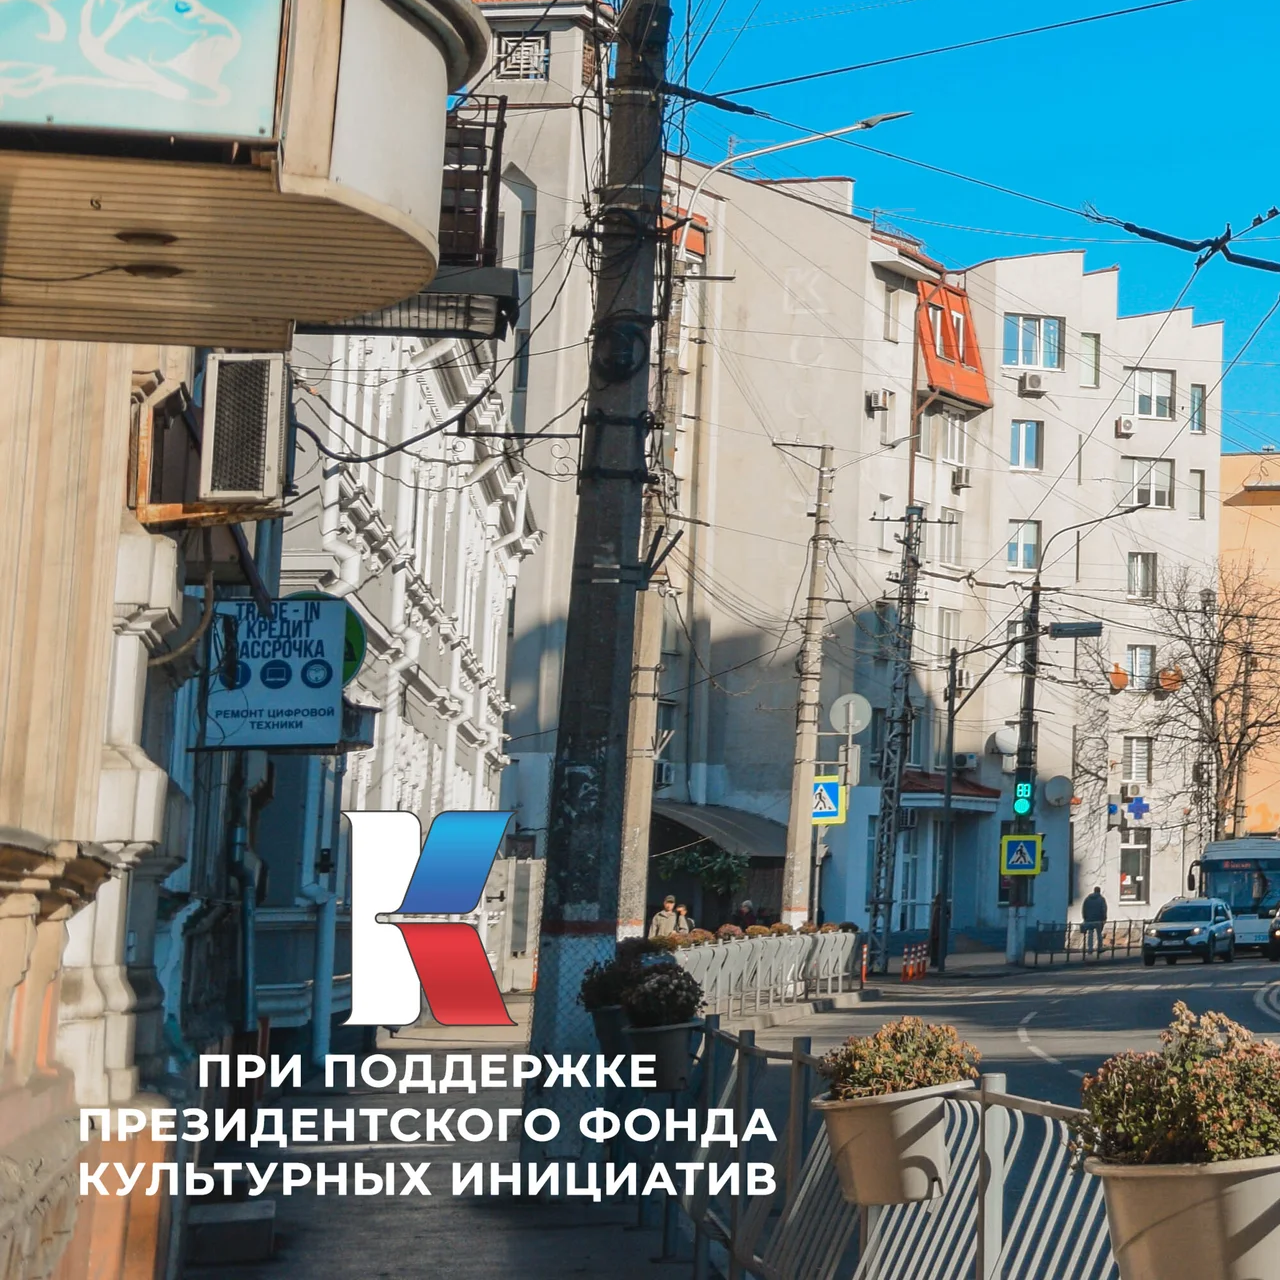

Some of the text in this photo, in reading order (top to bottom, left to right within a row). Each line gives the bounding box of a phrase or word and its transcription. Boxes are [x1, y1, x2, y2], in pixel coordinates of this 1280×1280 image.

[304, 602, 320, 619] IN
[246, 620, 313, 640] КРЕДИТ
[236, 639, 325, 658] АССРОЧКА
[215, 707, 335, 719] РЕМОНТ ЦИФРОВОЙ
[249, 720, 303, 730] ТЕХНИКИ
